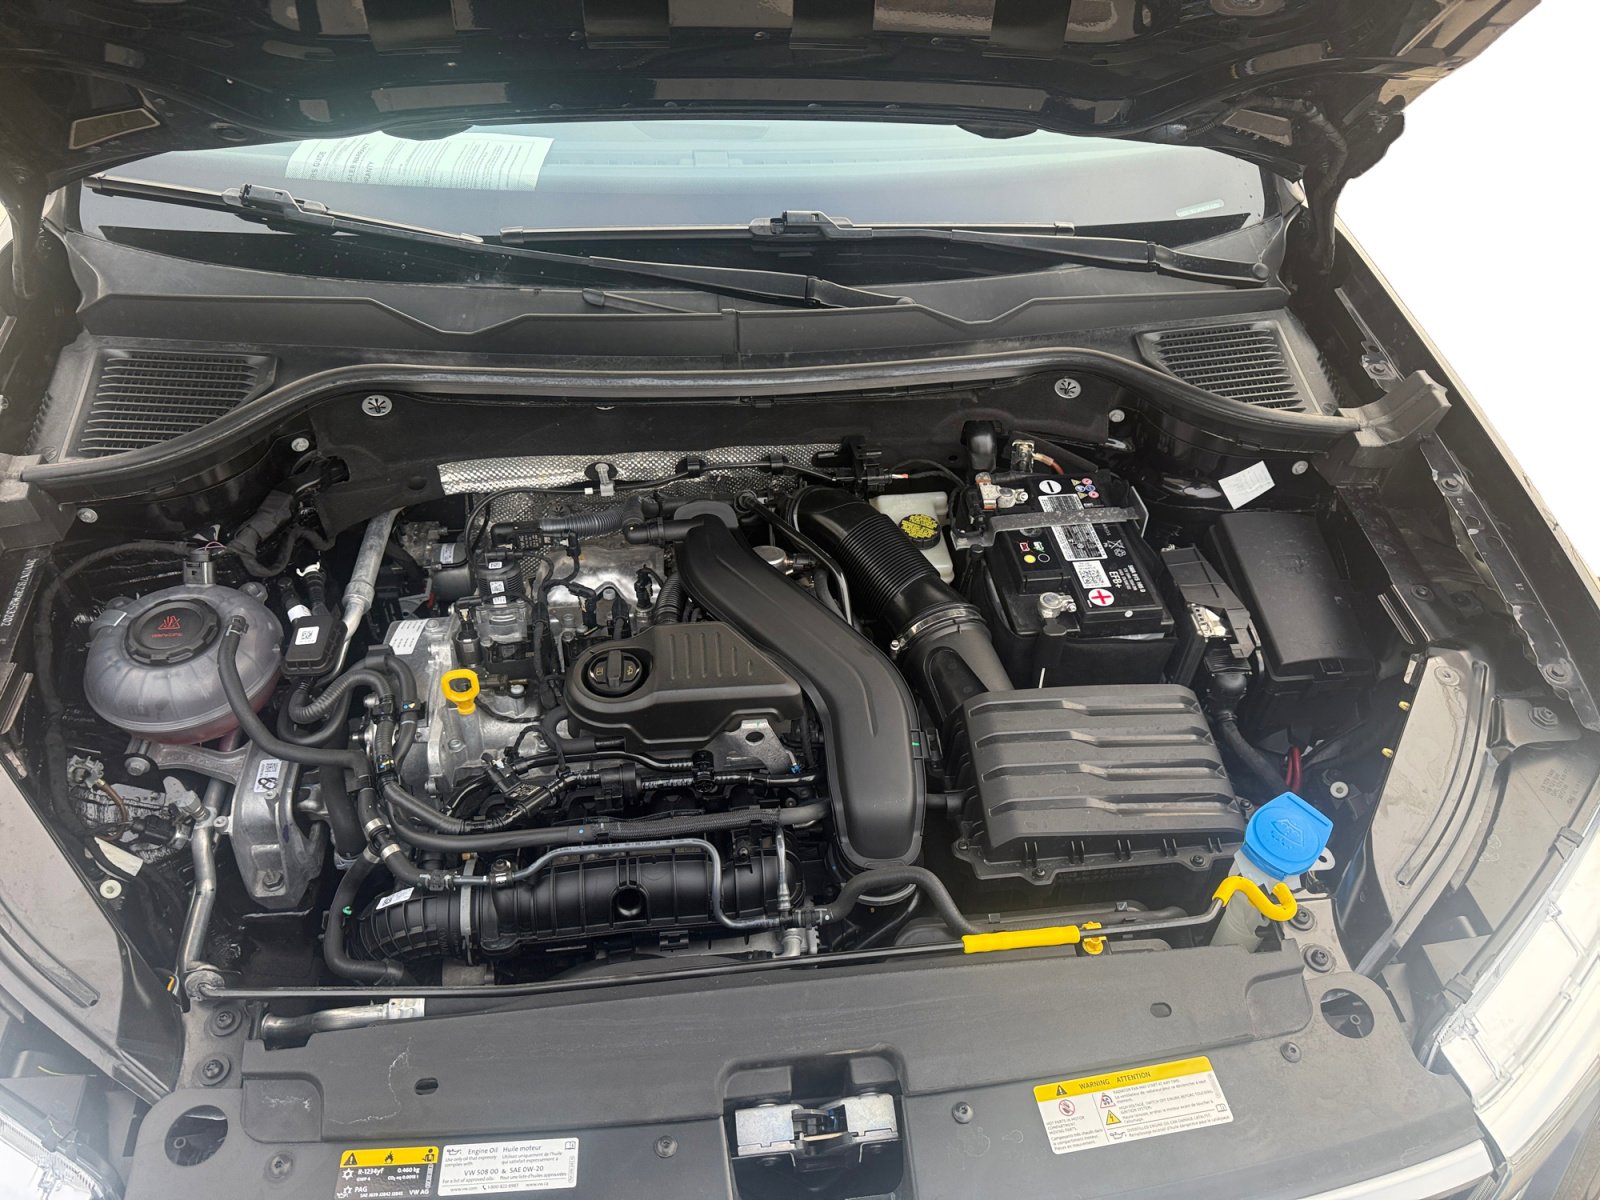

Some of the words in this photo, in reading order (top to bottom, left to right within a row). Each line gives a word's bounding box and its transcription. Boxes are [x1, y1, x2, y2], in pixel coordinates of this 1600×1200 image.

[1109, 571, 1123, 588] EFB+
[1078, 1079, 1110, 1089] WARNING
[1116, 1071, 1151, 1083] ATTENTION
[468, 1148, 489, 1156] Engine
[357, 1167, 385, 1176] R-1234yf
[509, 1166, 521, 1174] SAE
[354, 1185, 368, 1193] PAG
